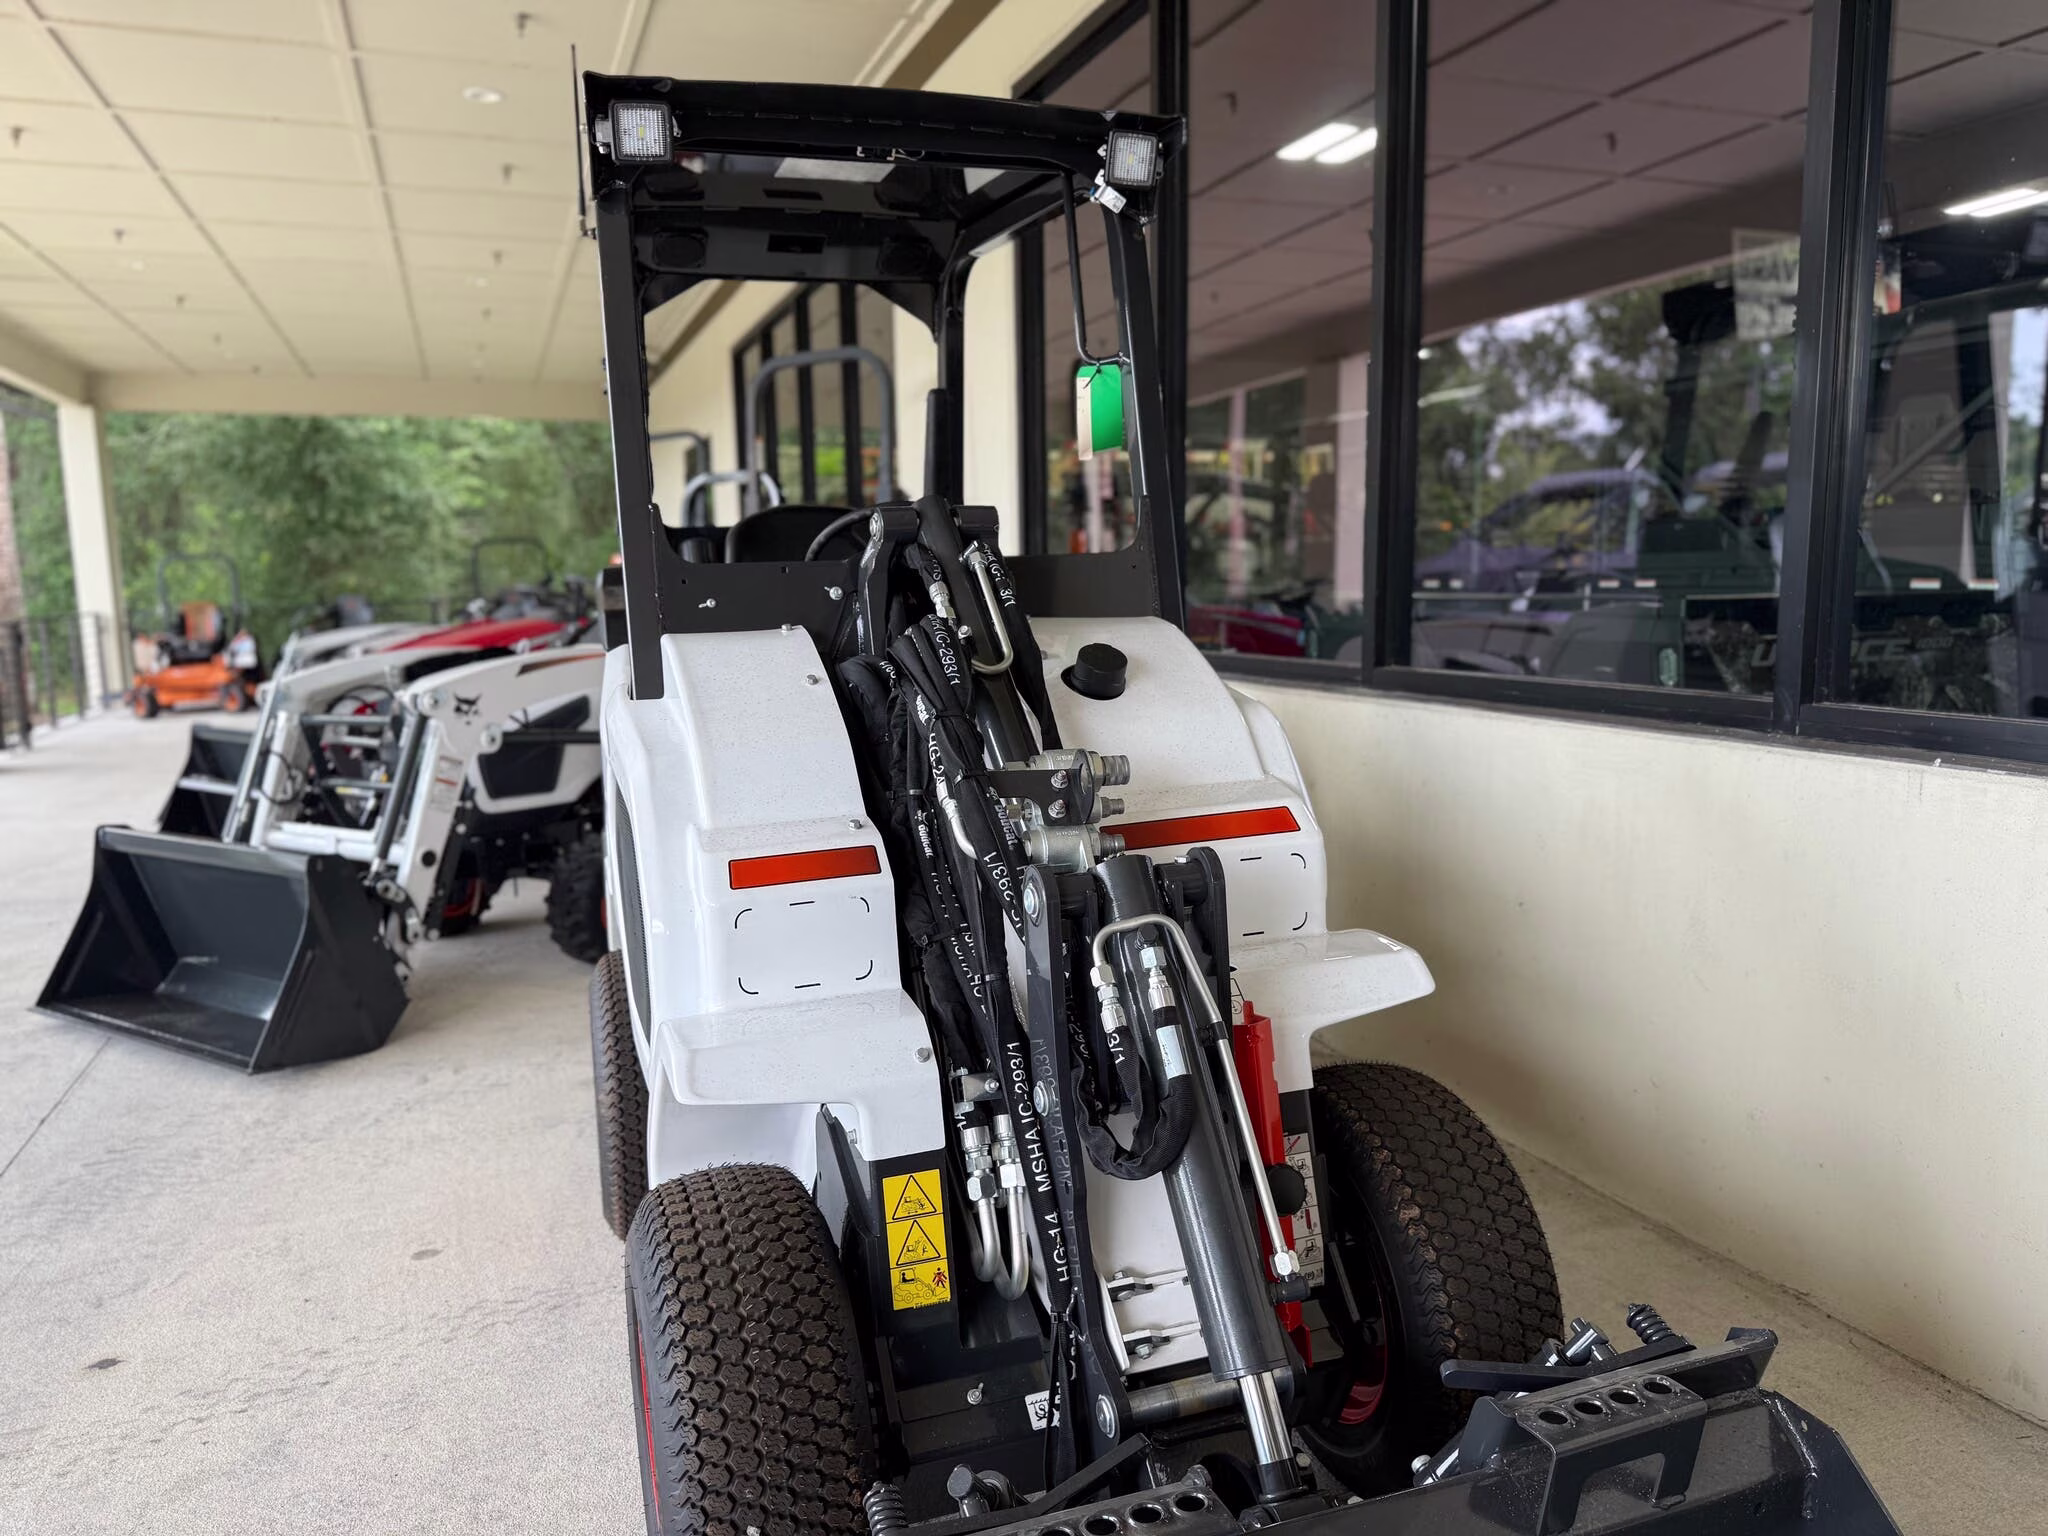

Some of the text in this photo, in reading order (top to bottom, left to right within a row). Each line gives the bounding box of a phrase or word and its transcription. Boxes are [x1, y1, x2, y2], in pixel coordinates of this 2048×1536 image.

[933, 628, 961, 685] IC-293/1
[1006, 1041, 1072, 1283] HG-14 MSHA IC-293/1
